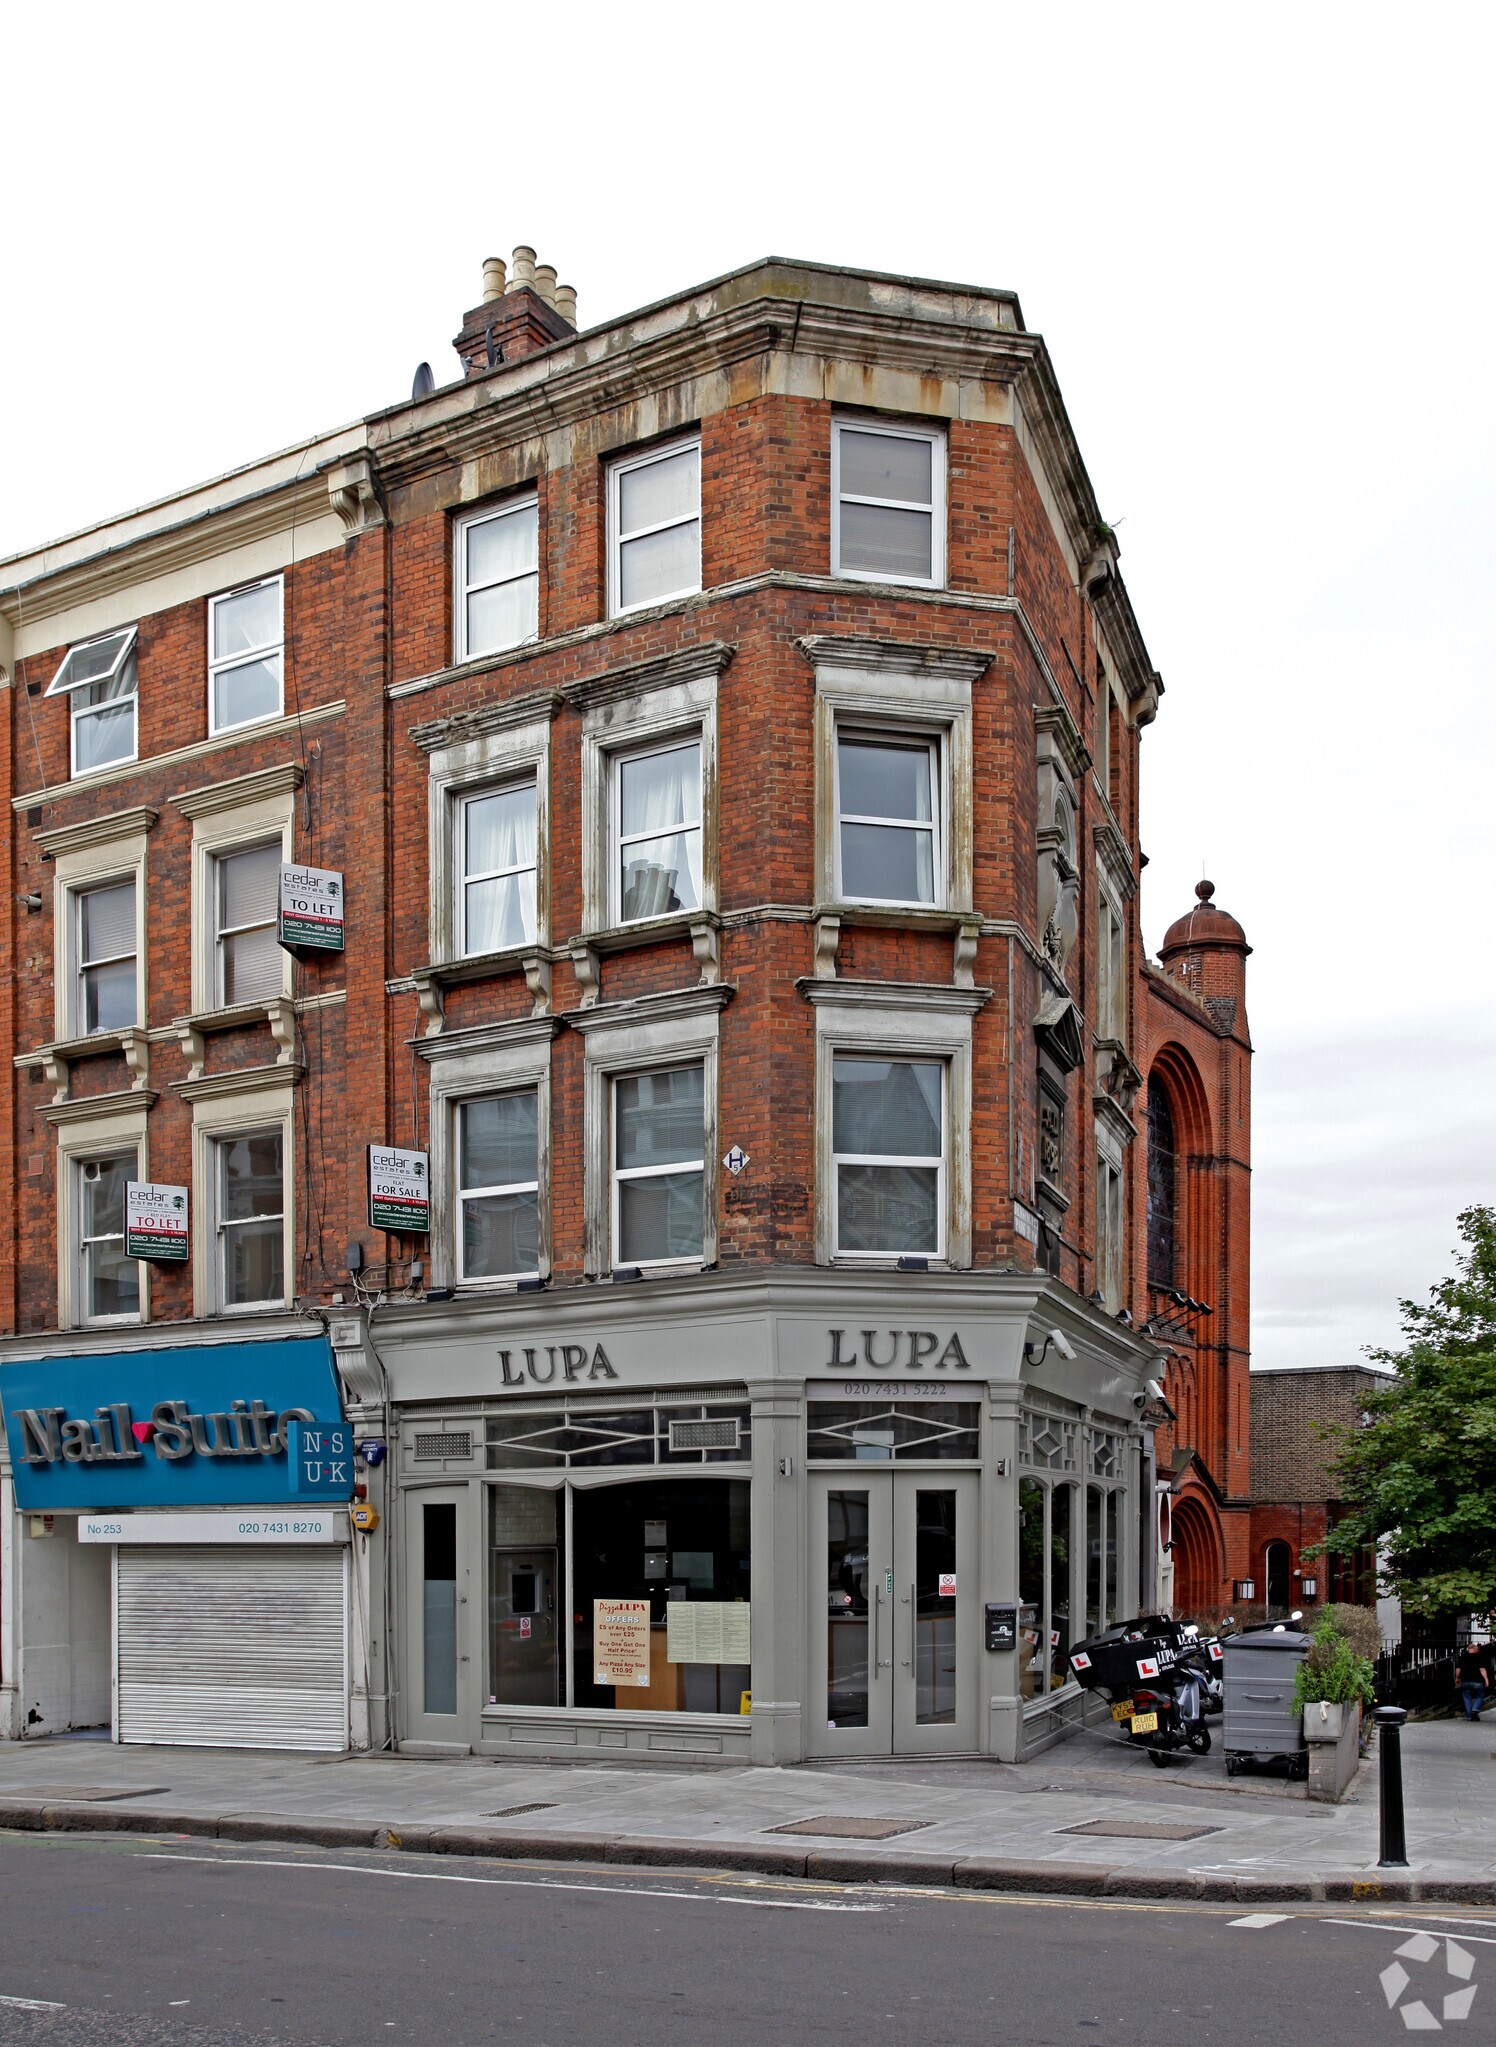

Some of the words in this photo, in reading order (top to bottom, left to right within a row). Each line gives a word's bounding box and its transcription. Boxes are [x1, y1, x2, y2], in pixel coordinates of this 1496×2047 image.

[284, 869, 324, 887] cedar
[284, 883, 324, 893] estates
[290, 899, 308, 911] TO
[313, 903, 335, 915] LET
[374, 1150, 410, 1168] cedar
[729, 1152, 743, 1168] H
[374, 1166, 410, 1174] estates
[130, 1186, 169, 1202] cedar
[377, 1185, 396, 1194] FOR
[399, 1188, 420, 1198] SALE
[136, 1217, 155, 1227] TO
[160, 1219, 181, 1229] LET
[827, 1330, 971, 1368] LUPA
[497, 1343, 618, 1385] LUPA
[845, 1384, 870, 1395] 020
[875, 1384, 907, 1395] 7431
[914, 1384, 947, 1395] 5222
[12, 1403, 142, 1463] Nail
[304, 1432, 322, 1452] N
[332, 1432, 343, 1453] S
[304, 1462, 323, 1482] U
[329, 1462, 347, 1482] K
[87, 1525, 101, 1534] No
[104, 1525, 122, 1534] 253
[239, 1524, 259, 1534] 020
[263, 1523, 289, 1533] 7431
[293, 1523, 321, 1533] 8270
[1075, 1658, 1087, 1667] L
[1156, 1649, 1176, 1664] LUPA
[1141, 1663, 1153, 1674] L
[1136, 1722, 1154, 1731] RUH
